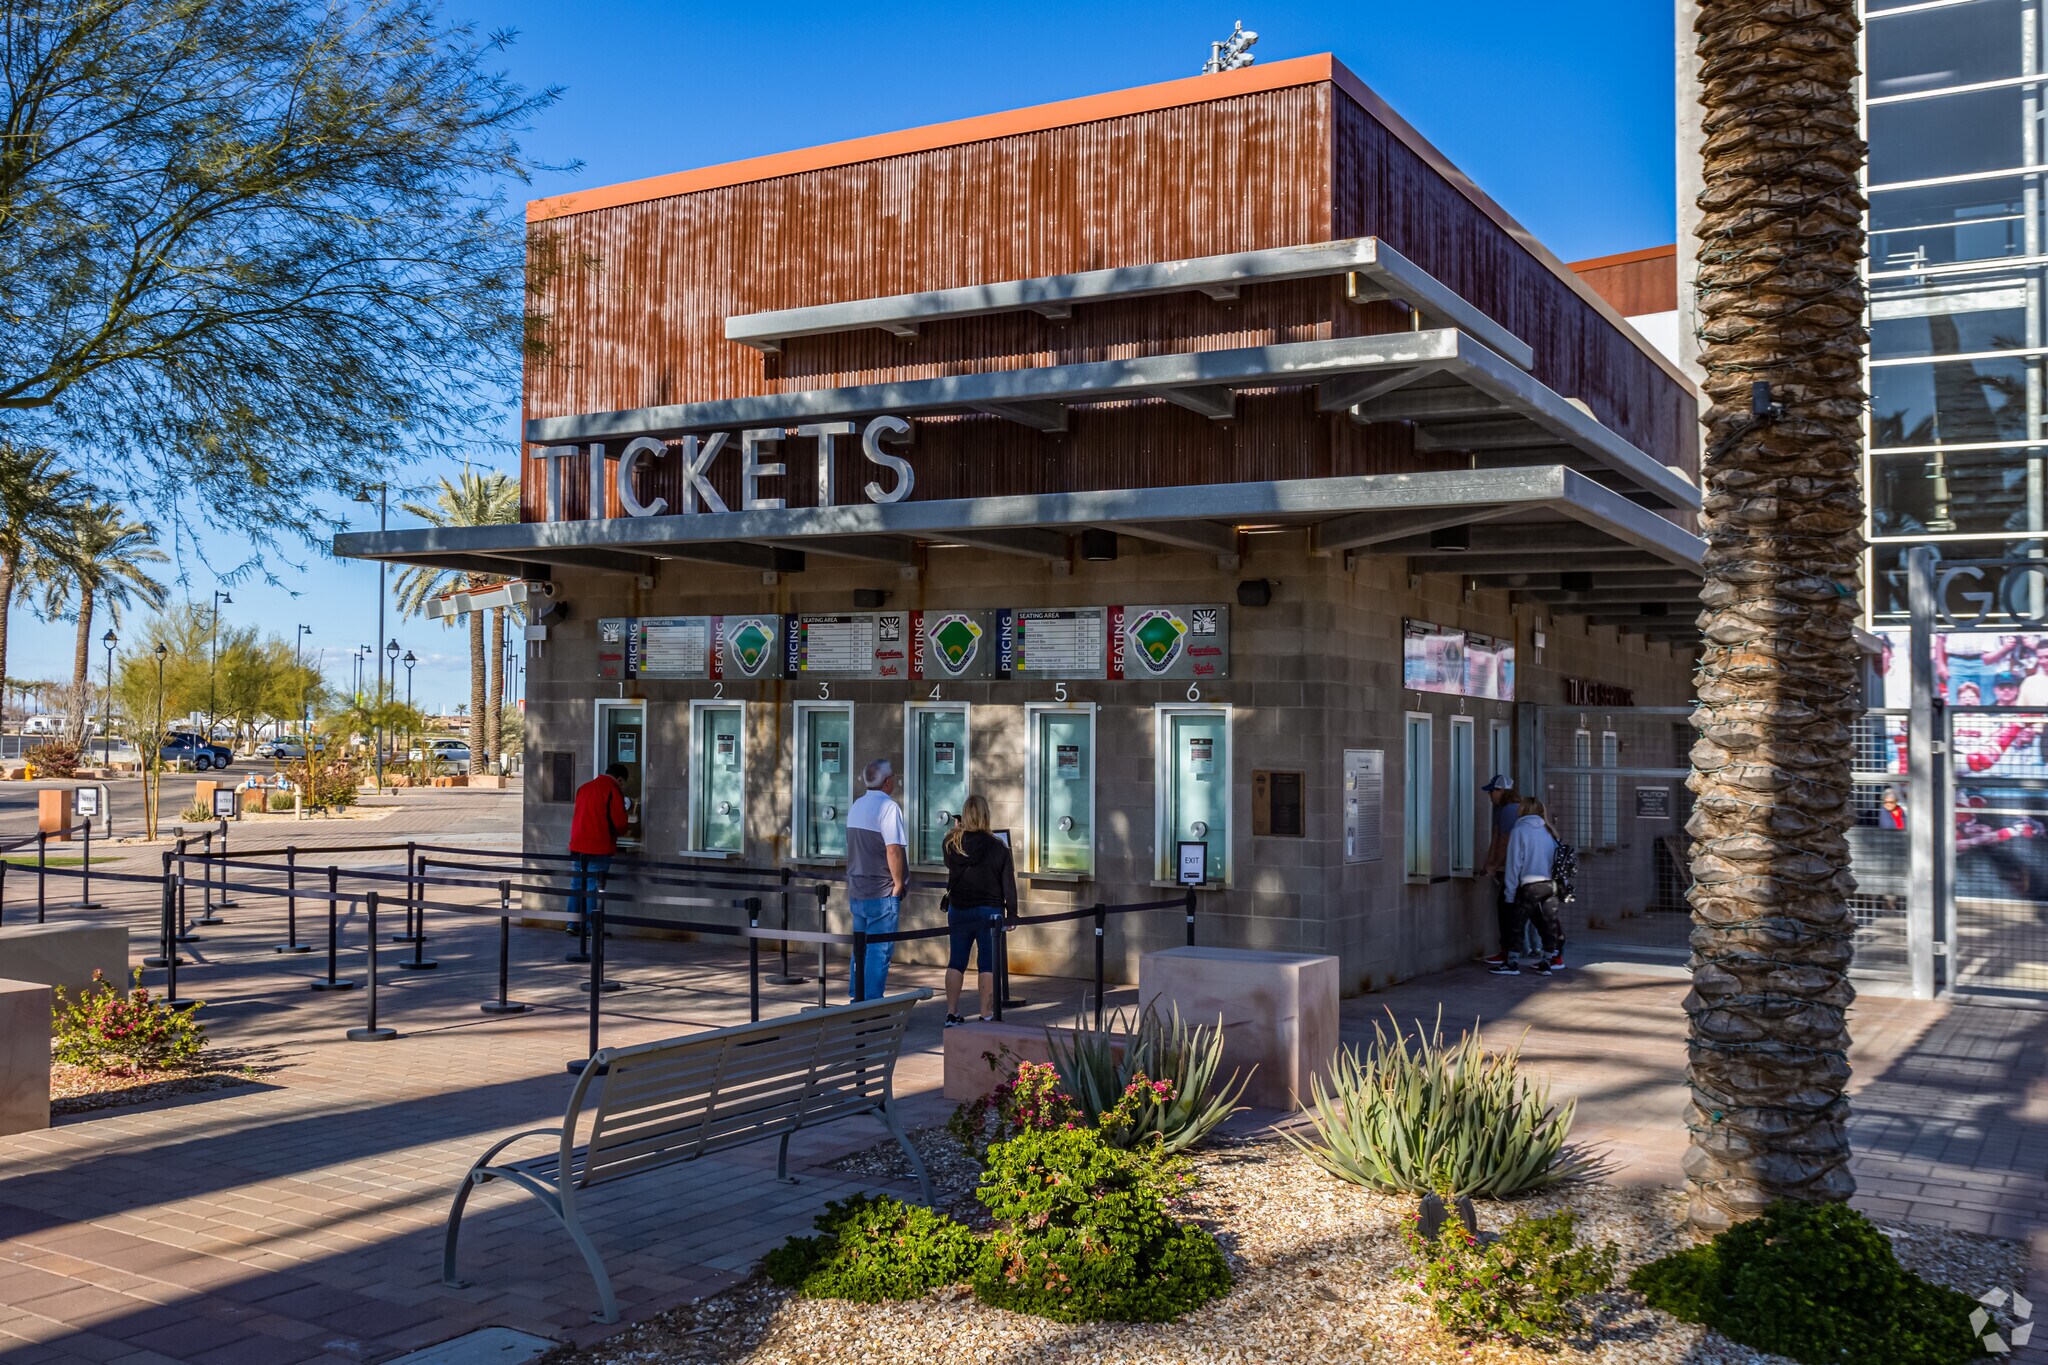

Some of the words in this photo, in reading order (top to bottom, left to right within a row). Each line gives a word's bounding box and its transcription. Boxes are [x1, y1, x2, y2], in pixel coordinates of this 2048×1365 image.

[531, 415, 915, 523] TICKETS
[629, 623, 638, 672] PRICING
[714, 622, 724, 673] SEATING
[789, 620, 799, 672] PRICING
[914, 618, 924, 672] SEATING
[1001, 616, 1012, 671] PRICING
[1114, 613, 1124, 672] SEATING
[618, 682, 623, 699] 1
[713, 682, 724, 699] 2
[818, 682, 830, 700] 3
[928, 683, 941, 701] 4
[1054, 682, 1067, 702] 5
[1186, 681, 1200, 702] 6
[1415, 693, 1423, 711] 7
[1459, 697, 1465, 715] 8
[1497, 702, 1503, 718] 9
[1184, 856, 1200, 864] EXIT
